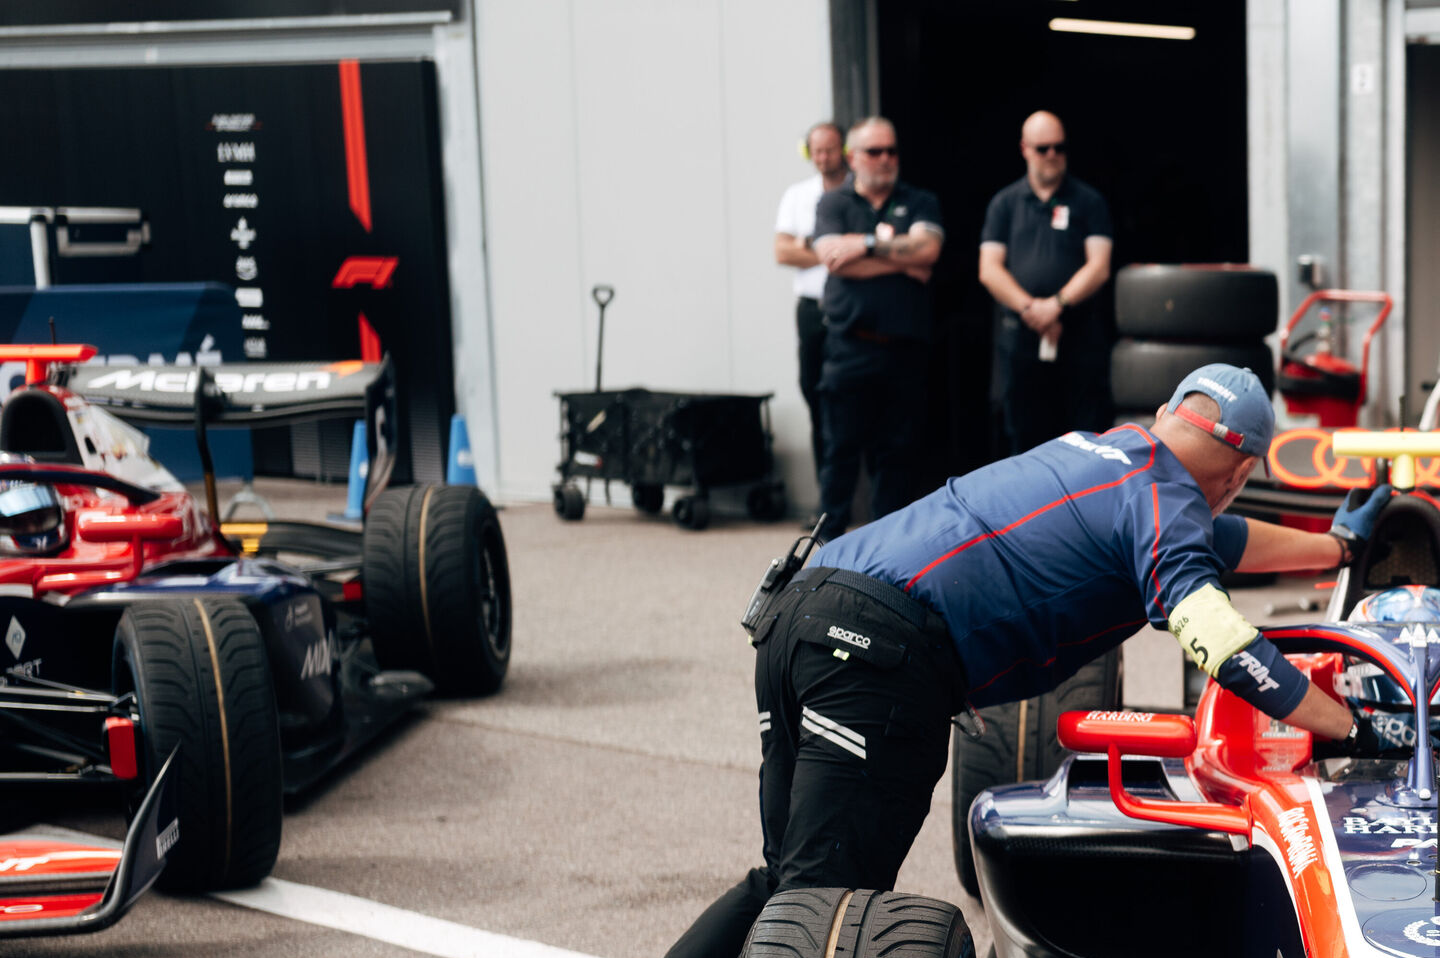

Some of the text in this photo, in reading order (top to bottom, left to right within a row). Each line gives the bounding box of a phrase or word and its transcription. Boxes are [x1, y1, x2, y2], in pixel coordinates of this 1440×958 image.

[827, 625, 871, 649] sparco
[1189, 637, 1209, 665] 5
[156, 816, 180, 860] PIRELLI
